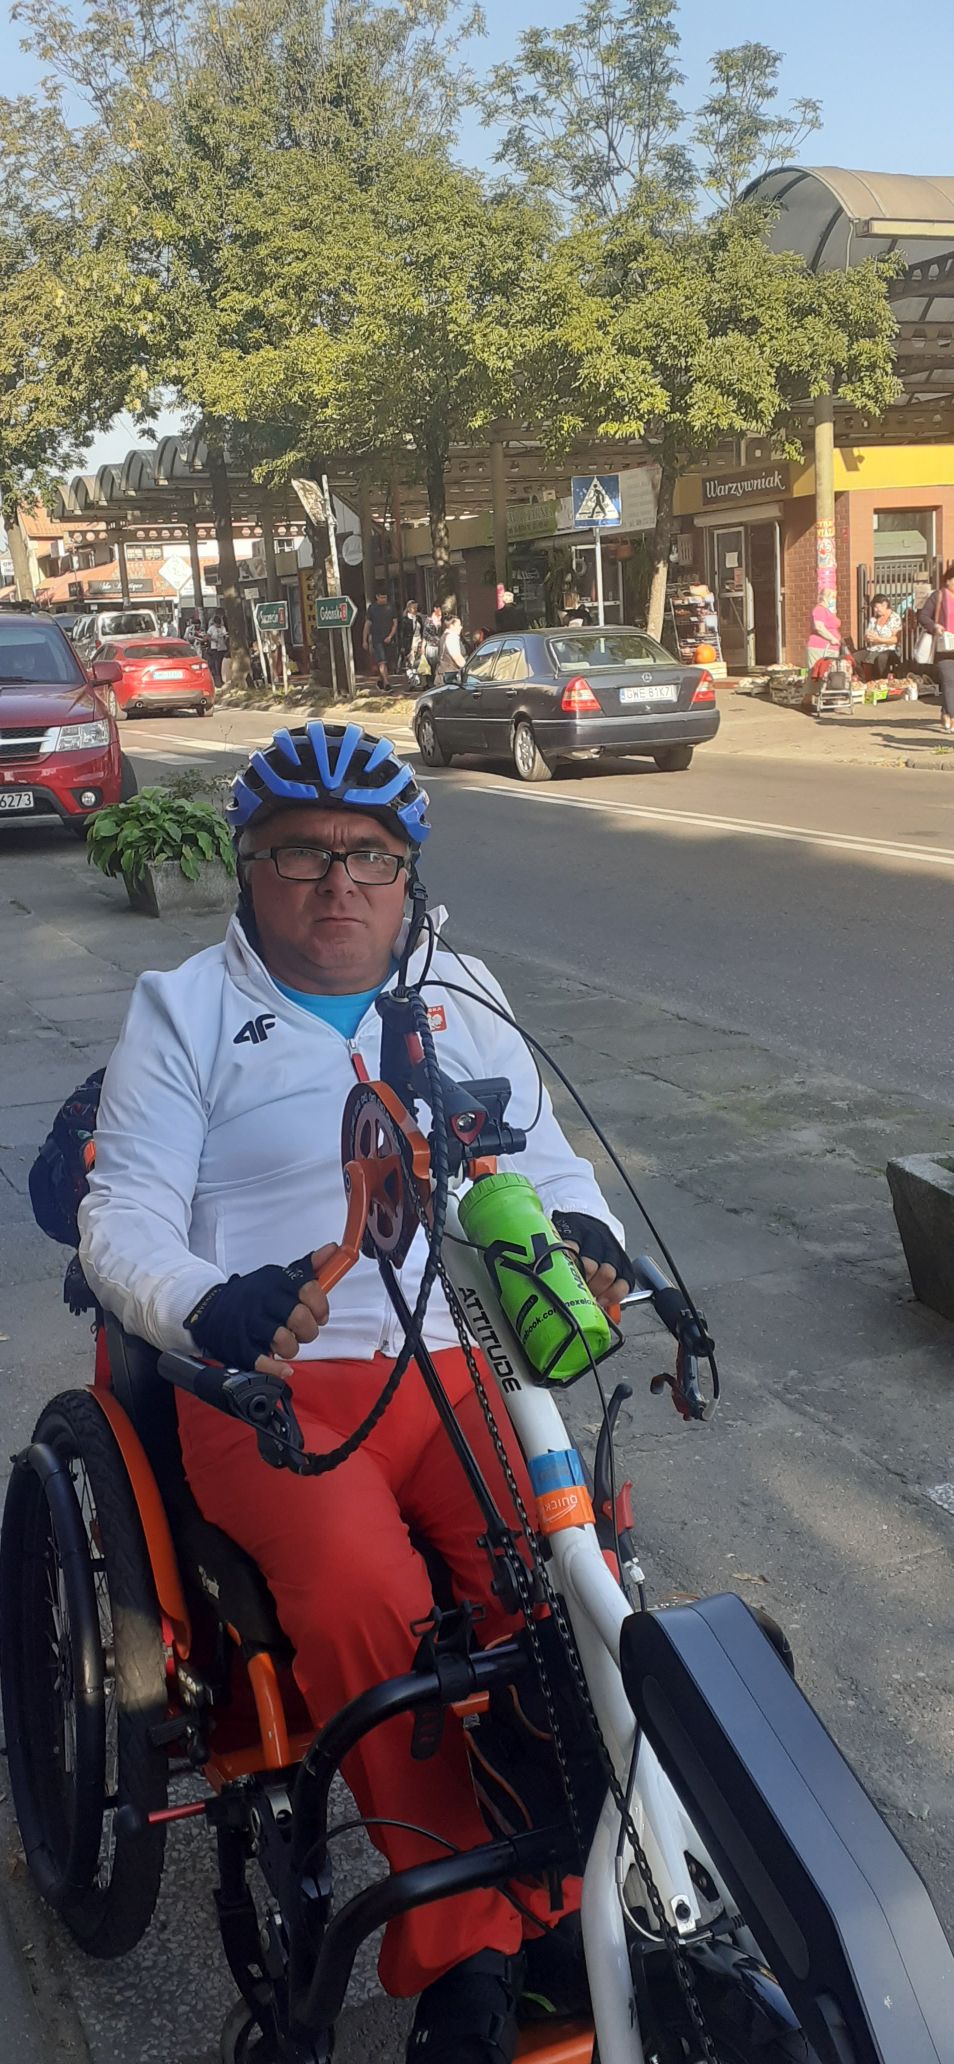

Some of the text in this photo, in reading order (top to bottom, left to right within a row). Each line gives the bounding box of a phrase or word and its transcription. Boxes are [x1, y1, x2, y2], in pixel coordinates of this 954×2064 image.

[705, 470, 786, 499] Warzywniak
[0, 793, 32, 808] 6273
[233, 1013, 276, 1045] 4F
[458, 1287, 522, 1394] ATTITUDE
